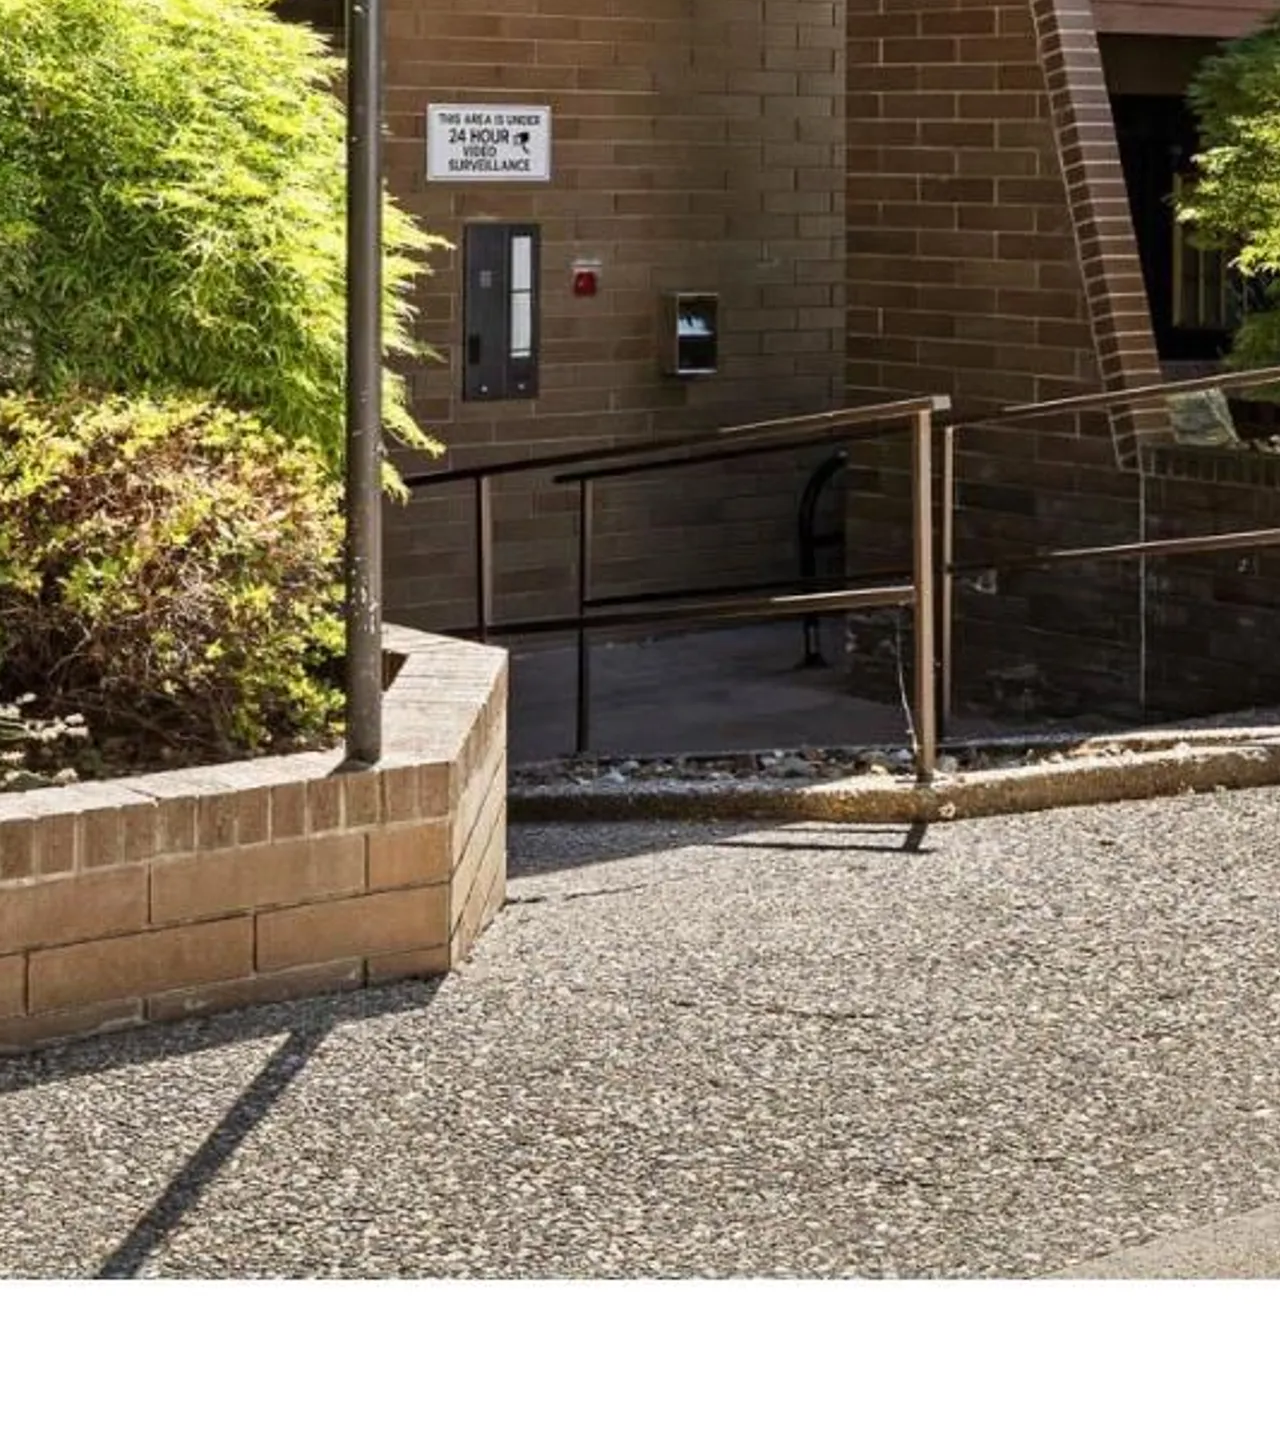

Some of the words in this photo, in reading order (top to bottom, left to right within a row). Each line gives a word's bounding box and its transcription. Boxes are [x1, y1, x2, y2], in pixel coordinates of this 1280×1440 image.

[464, 113, 492, 126] AREA
[448, 128, 467, 145] 24
[470, 128, 510, 145] HOUR
[463, 146, 497, 158] VIDEO
[448, 159, 531, 172] SURVEILLANCE
